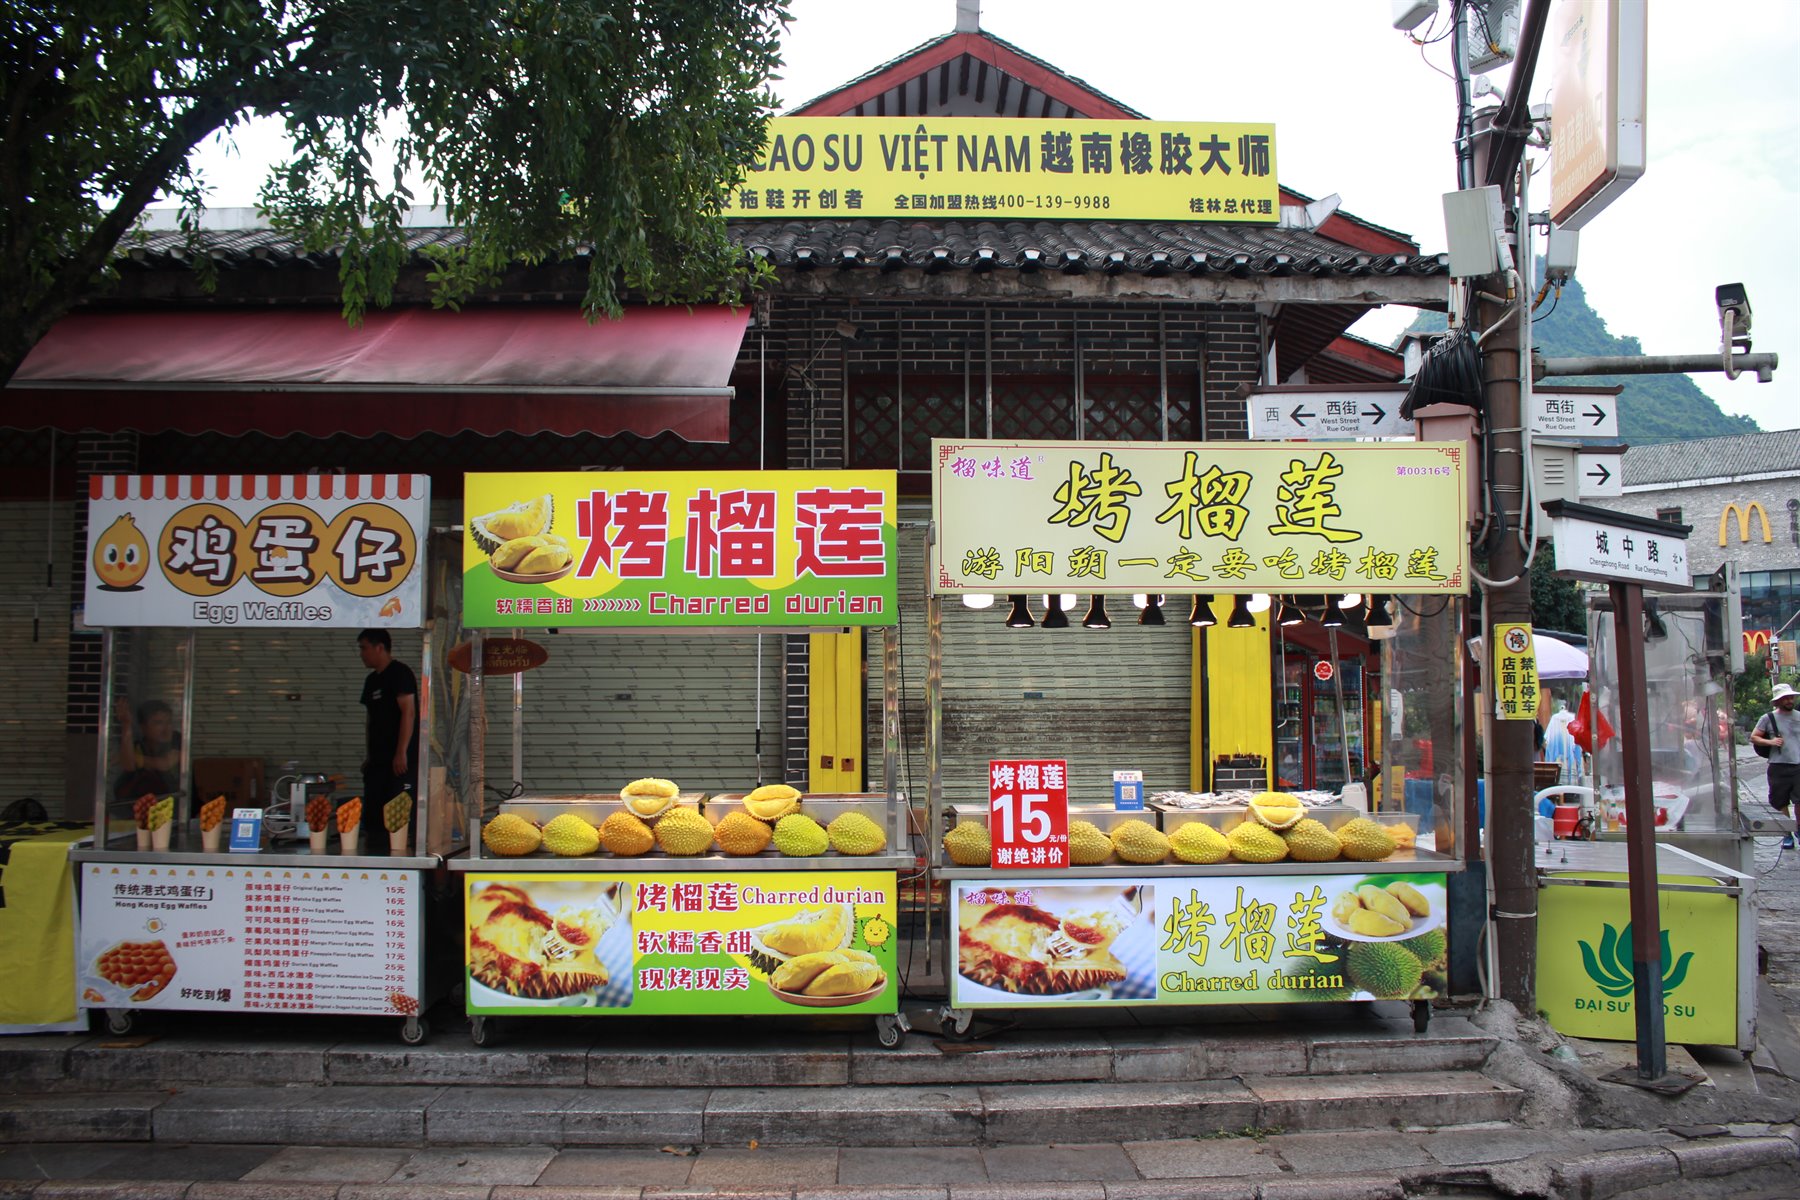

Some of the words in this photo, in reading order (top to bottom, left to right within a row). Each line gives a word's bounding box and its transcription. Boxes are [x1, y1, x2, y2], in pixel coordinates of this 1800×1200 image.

[824, 134, 862, 172] SU
[879, 124, 948, 180] VIỆT
[957, 135, 1030, 172] NAM
[1041, 131, 1270, 177] 越南橡胶大师
[1190, 198, 1272, 214] 桂林总代理
[1265, 407, 1279, 422] 西
[1326, 401, 1357, 415] 西街
[1546, 400, 1574, 414] 西街
[951, 456, 1034, 480] 榴味道
[1396, 466, 1452, 477] 第00316号
[1048, 450, 1362, 543] 烤榴莲
[574, 488, 887, 580] 烤榴莲
[165, 514, 405, 586] 鸡蛋仔
[1596, 530, 1658, 563] 城中路
[962, 546, 1450, 581] 游阳朔一定要吃烤榴莲
[1590, 558, 1617, 570] Chengzhong
[1618, 562, 1629, 570] Road
[1644, 566, 1667, 577] Chengzhong
[193, 602, 238, 624] Egg
[244, 602, 332, 621] Waffles
[496, 597, 574, 615] 软糯香甜
[648, 590, 769, 615] Charred
[785, 589, 883, 615] durian
[1510, 630, 1525, 649] 停
[1502, 657, 1517, 714] 店面门前
[1520, 657, 1536, 713] 禁止停车
[992, 764, 1064, 790] 烤榴莲
[993, 794, 1051, 843] 15
[997, 847, 1063, 865] 谢绝讲价
[114, 884, 206, 897] 传统港式鸡蛋仔
[635, 882, 739, 913] 烤榴莲
[742, 886, 817, 905] Charred
[822, 885, 885, 904] durian
[1161, 884, 1340, 966] 烤榴莲
[638, 930, 753, 955] 软糯香甜
[638, 967, 750, 991] 现烤现卖
[1161, 970, 1258, 994] Charred
[1266, 970, 1345, 991] durian
[181, 988, 232, 1002] 好吃到爆
[1575, 998, 1602, 1013] ĐẠI
[1606, 1001, 1630, 1013] SƯ
[1674, 1005, 1695, 1017] SU
